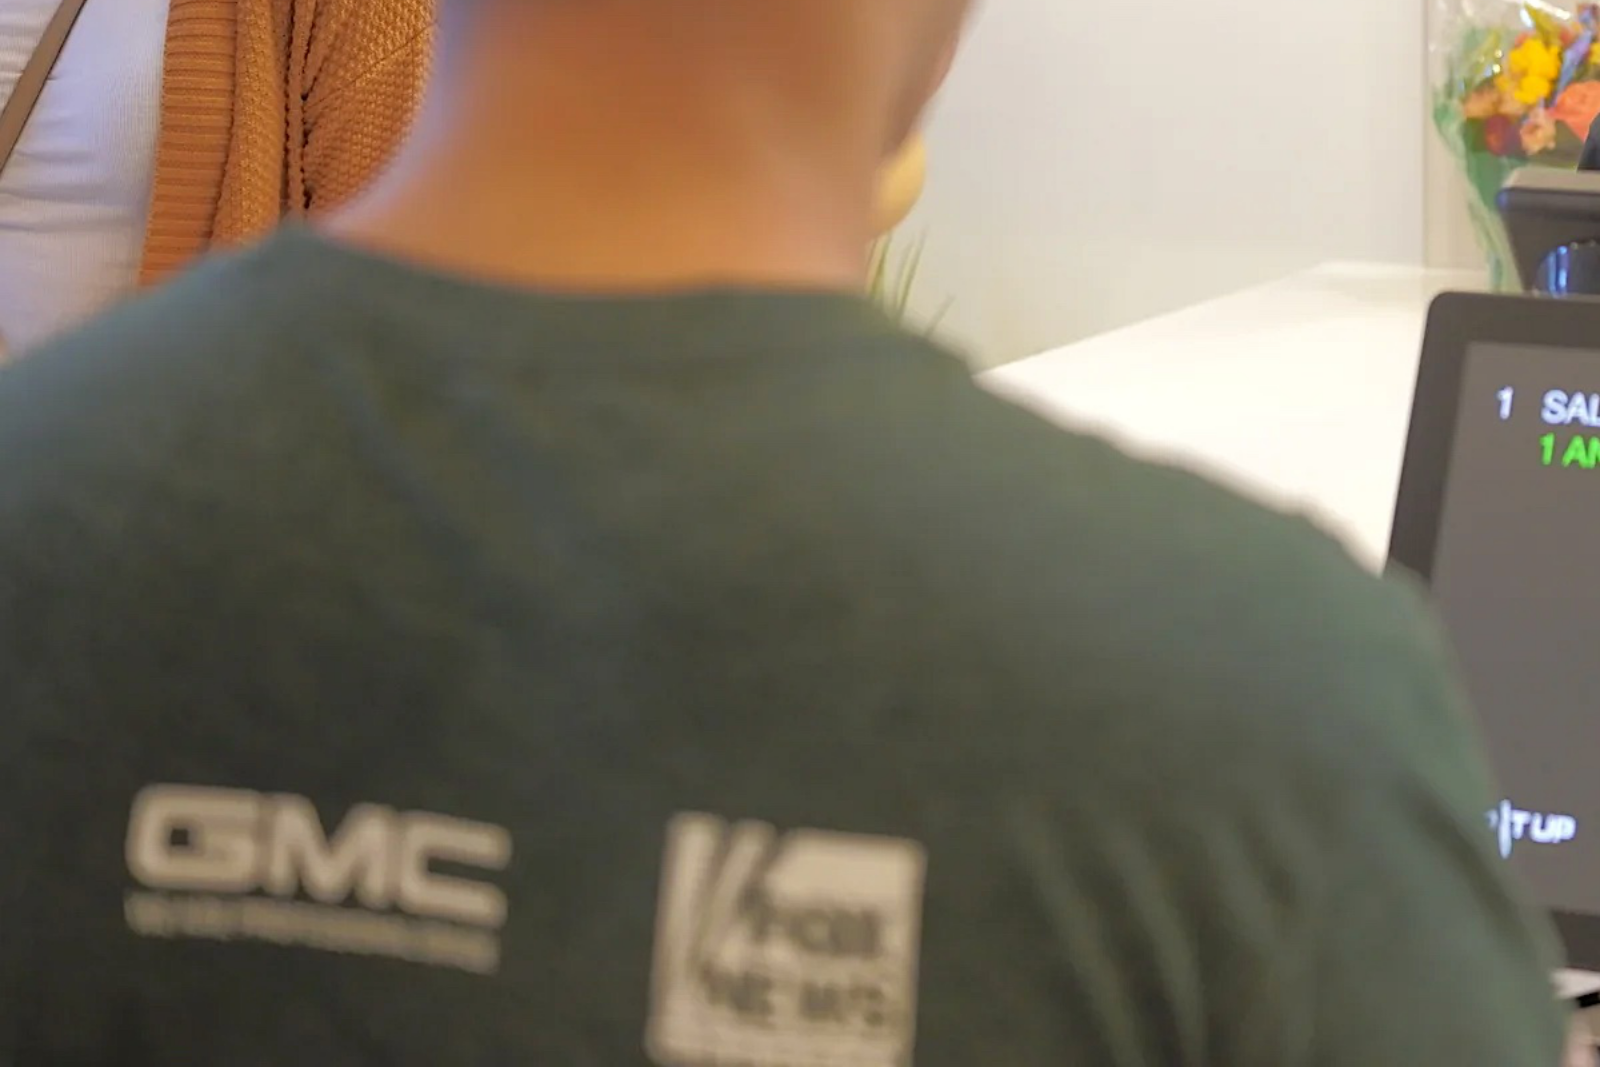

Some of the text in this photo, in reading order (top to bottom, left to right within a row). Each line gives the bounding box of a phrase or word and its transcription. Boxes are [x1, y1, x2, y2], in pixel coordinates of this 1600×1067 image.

[1497, 386, 1514, 420] 1
[1540, 433, 1555, 466] 1
[126, 783, 511, 931] GMC
